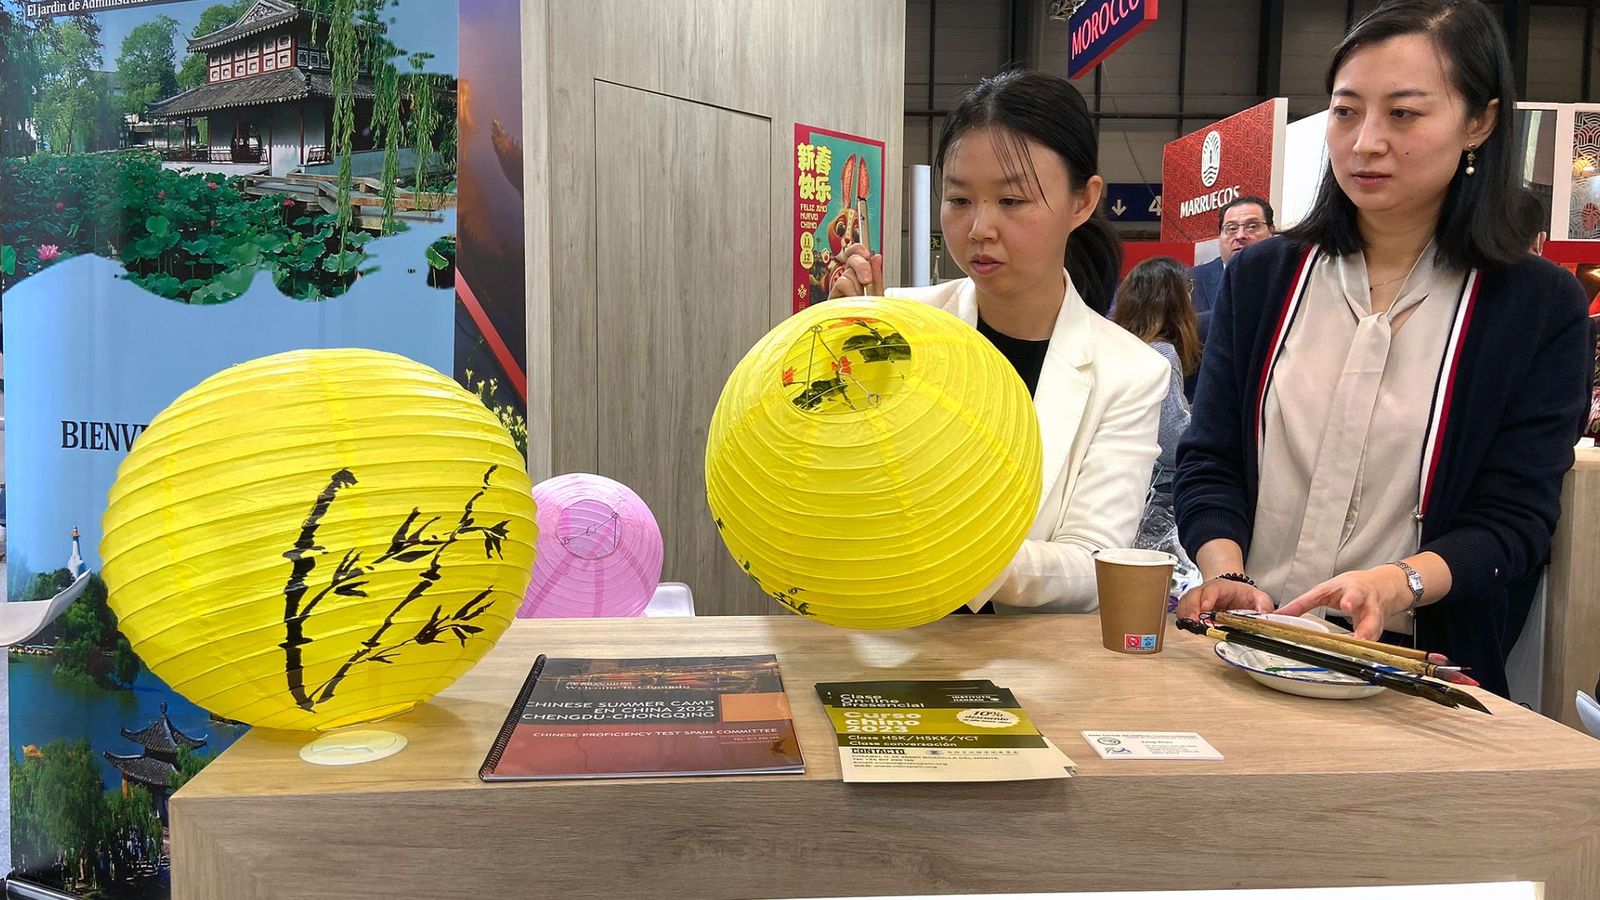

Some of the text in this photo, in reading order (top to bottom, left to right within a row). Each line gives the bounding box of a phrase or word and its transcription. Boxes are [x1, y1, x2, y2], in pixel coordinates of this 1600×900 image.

[27, 4, 36, 17] El
[68, 0, 81, 11] de
[797, 142, 832, 176] 新春
[797, 171, 832, 203] 快乐
[1148, 195, 1162, 216] 4
[1180, 185, 1241, 219] MARRUECOS
[800, 203, 815, 213] FELIZ
[800, 212, 819, 222] NUEVO
[800, 221, 817, 230] CHINO
[803, 237, 811, 246] 11
[803, 253, 811, 262] 12
[60, 420, 149, 453] BIENV
[621, 706, 672, 714] CHINA
[521, 712, 715, 720] CHENGDU-CHONGQING
[844, 711, 922, 719] Curso
[844, 717, 921, 726] chino
[846, 725, 909, 733] 2023
